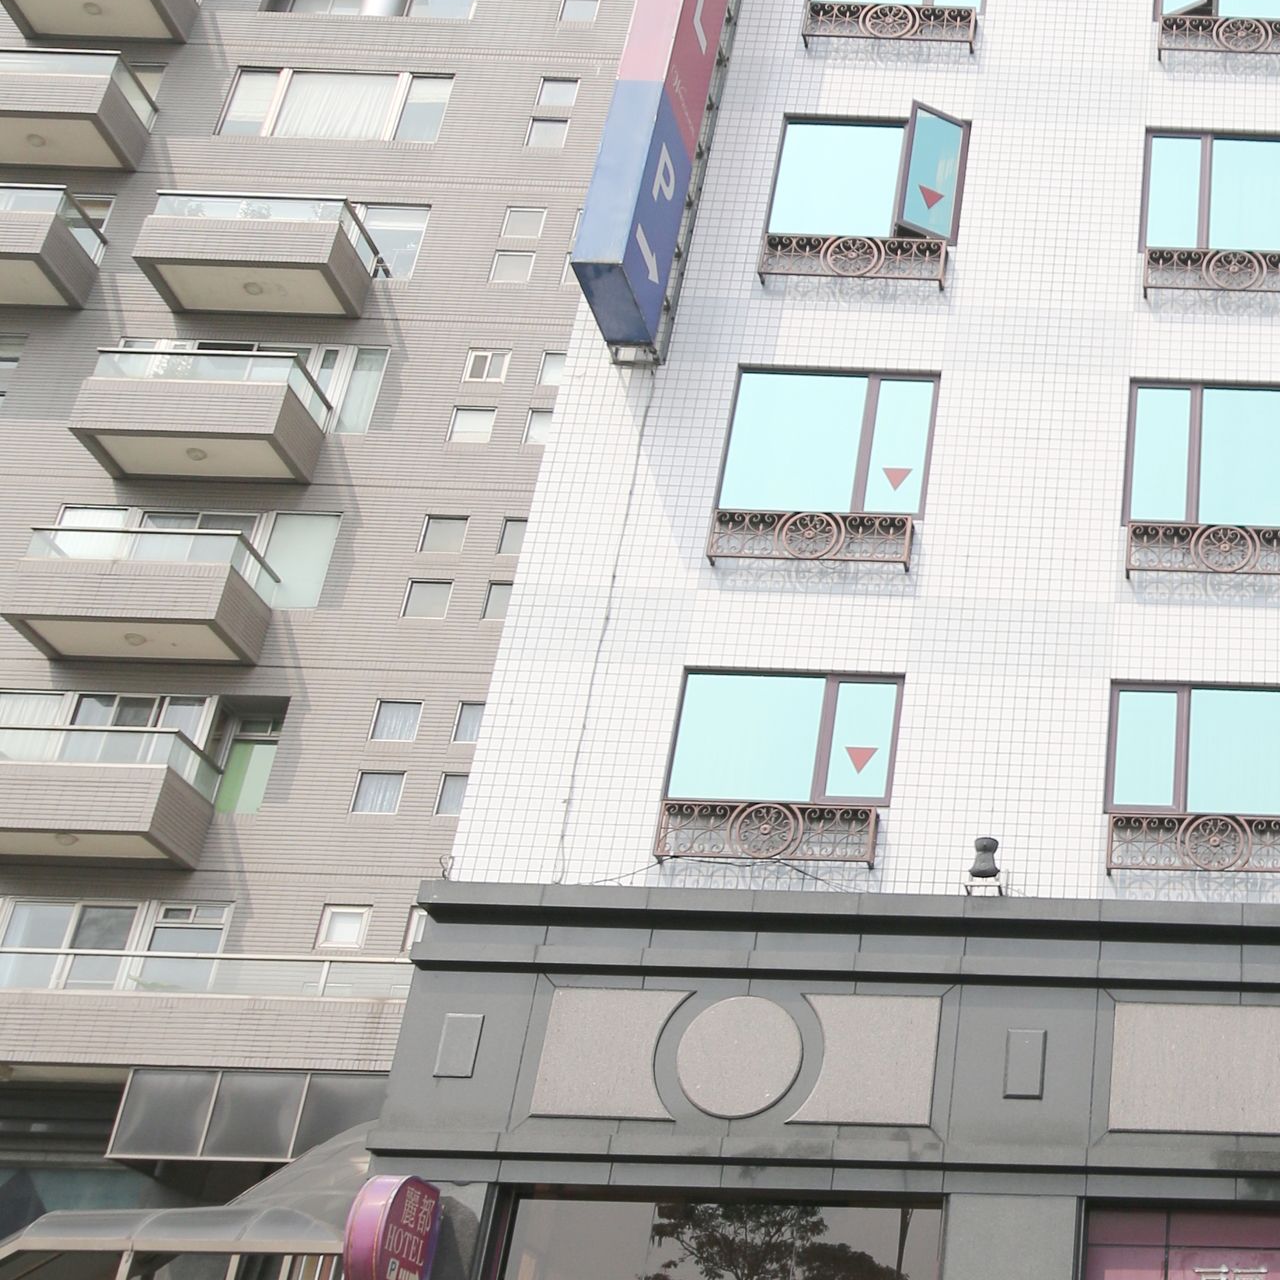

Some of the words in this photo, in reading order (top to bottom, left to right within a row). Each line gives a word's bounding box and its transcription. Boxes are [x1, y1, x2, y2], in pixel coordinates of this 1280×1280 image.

[652, 141, 675, 202] P
[402, 1186, 436, 1236] 麗都
[384, 1223, 424, 1267] HOTEL
